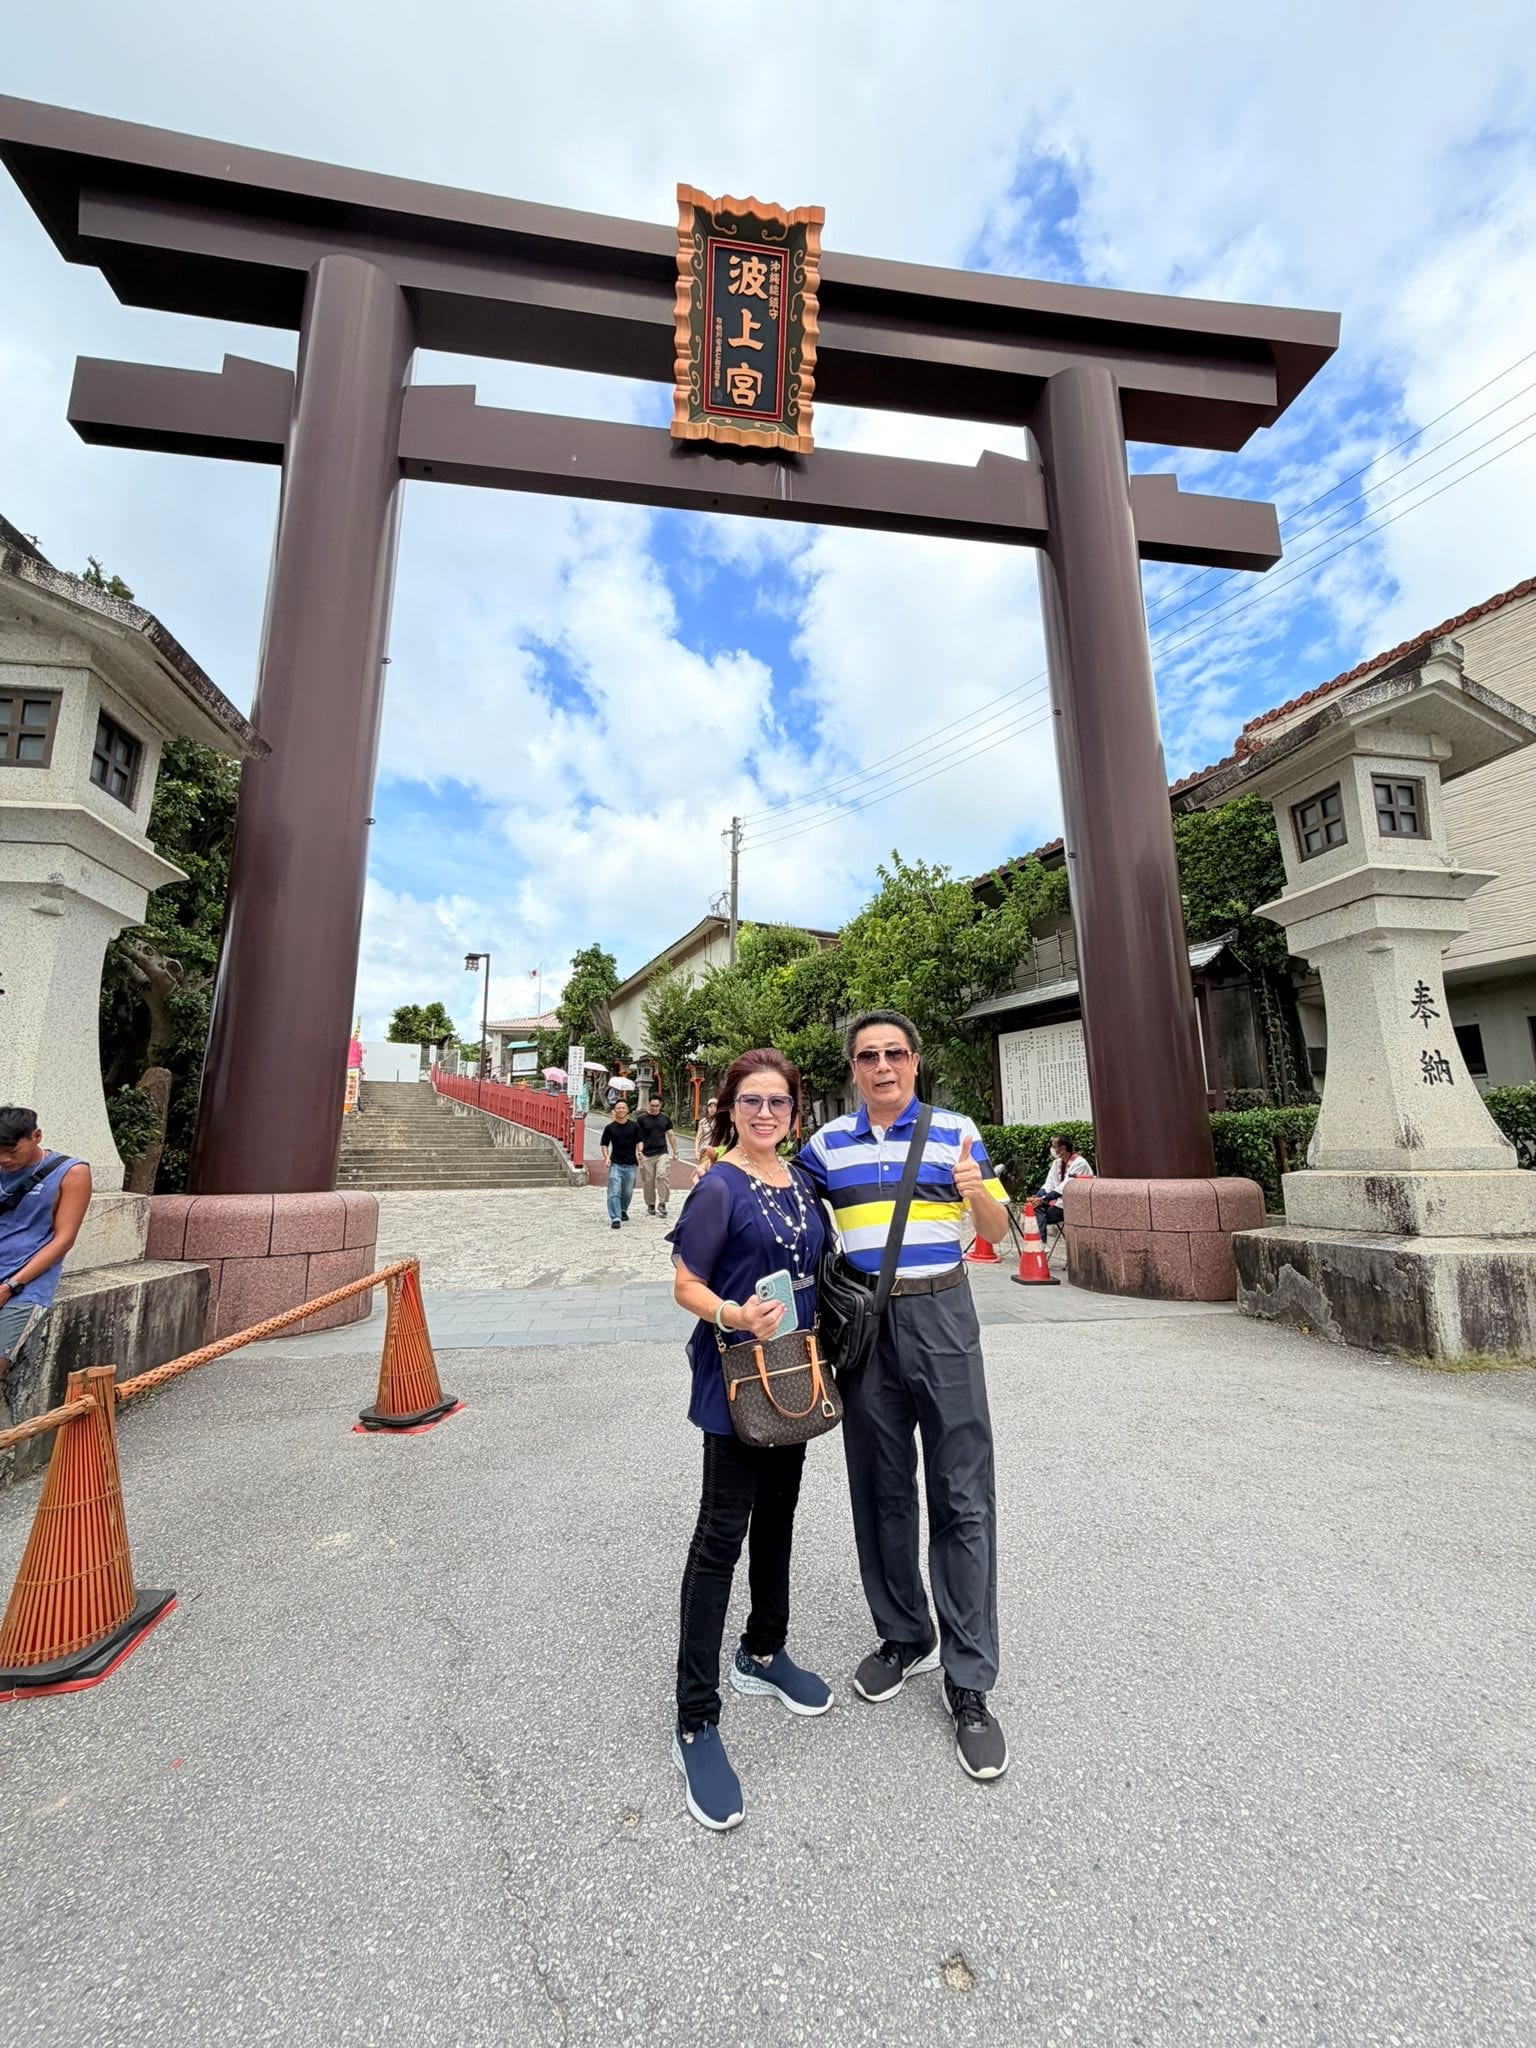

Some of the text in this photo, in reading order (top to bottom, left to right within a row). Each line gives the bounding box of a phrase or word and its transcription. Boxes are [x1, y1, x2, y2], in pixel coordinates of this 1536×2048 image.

[727, 255, 768, 407] 波上宮
[1410, 980, 1454, 1085] 奉納
